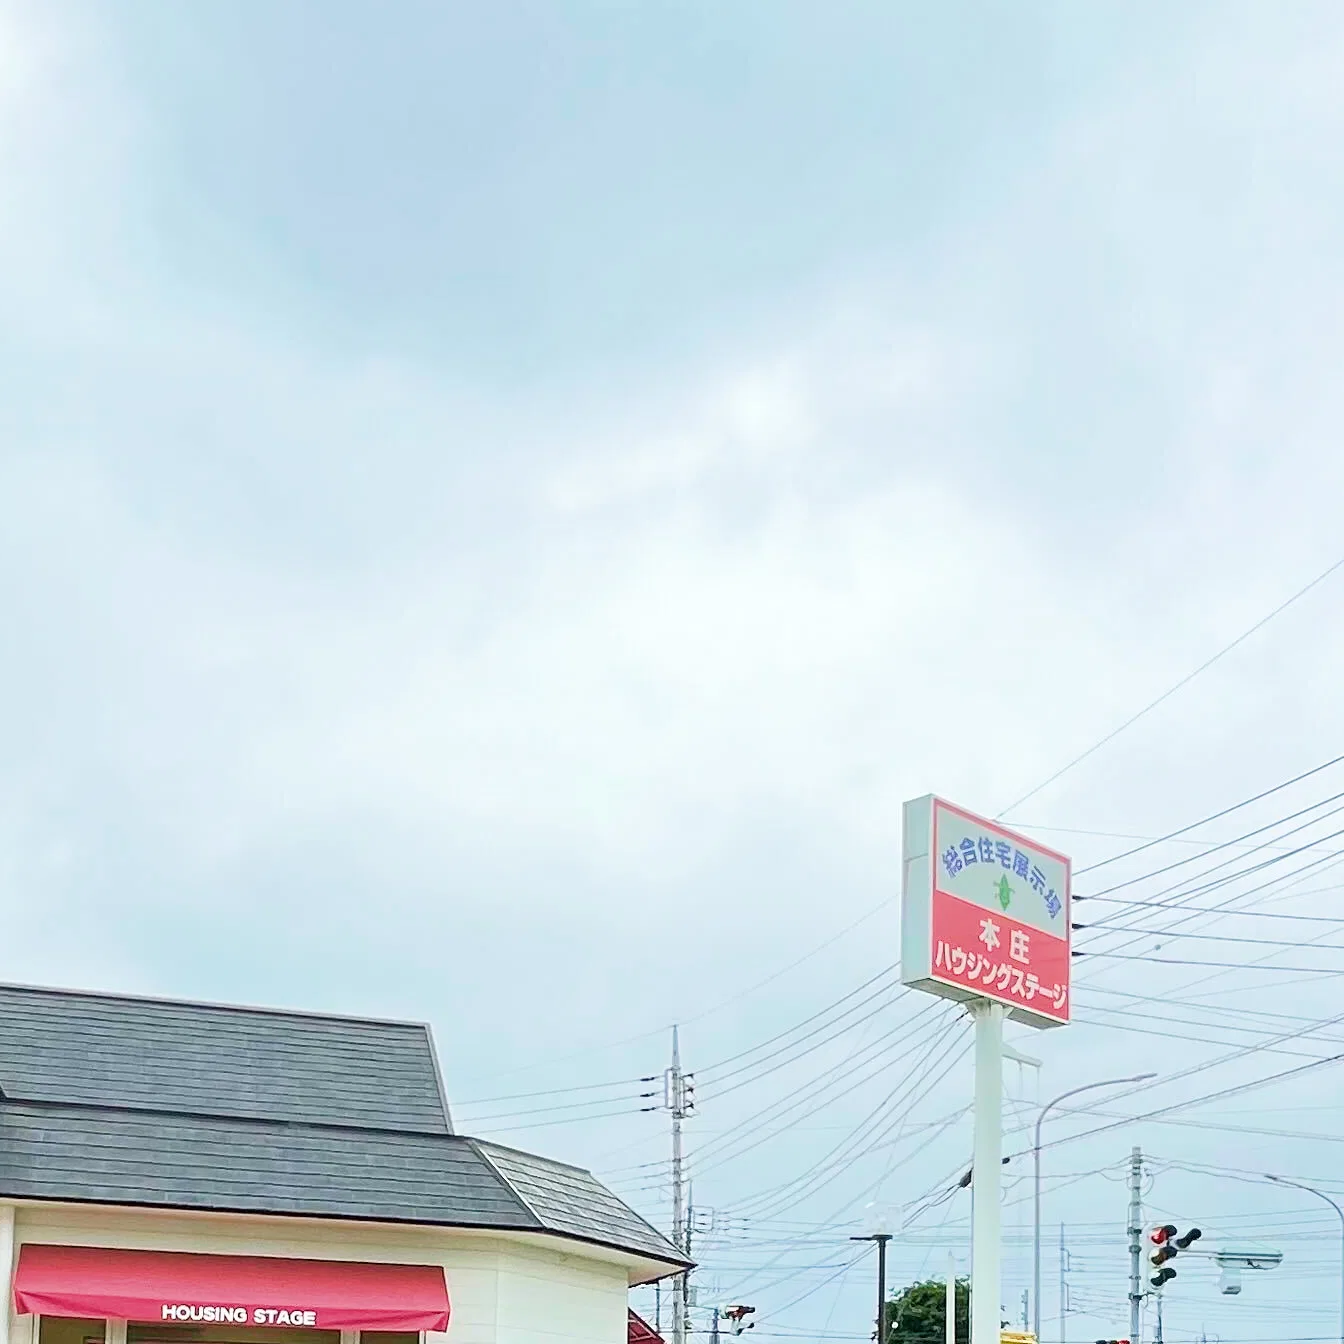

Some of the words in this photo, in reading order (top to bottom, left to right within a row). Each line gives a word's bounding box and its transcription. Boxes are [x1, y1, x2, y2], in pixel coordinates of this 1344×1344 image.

[942, 836, 1063, 920] 総合住宅展示場
[977, 917, 1031, 965] 本庄
[935, 940, 1067, 1010] ハウジングステージ
[161, 1304, 248, 1323] HOUSING
[253, 1308, 317, 1326] STAGE
